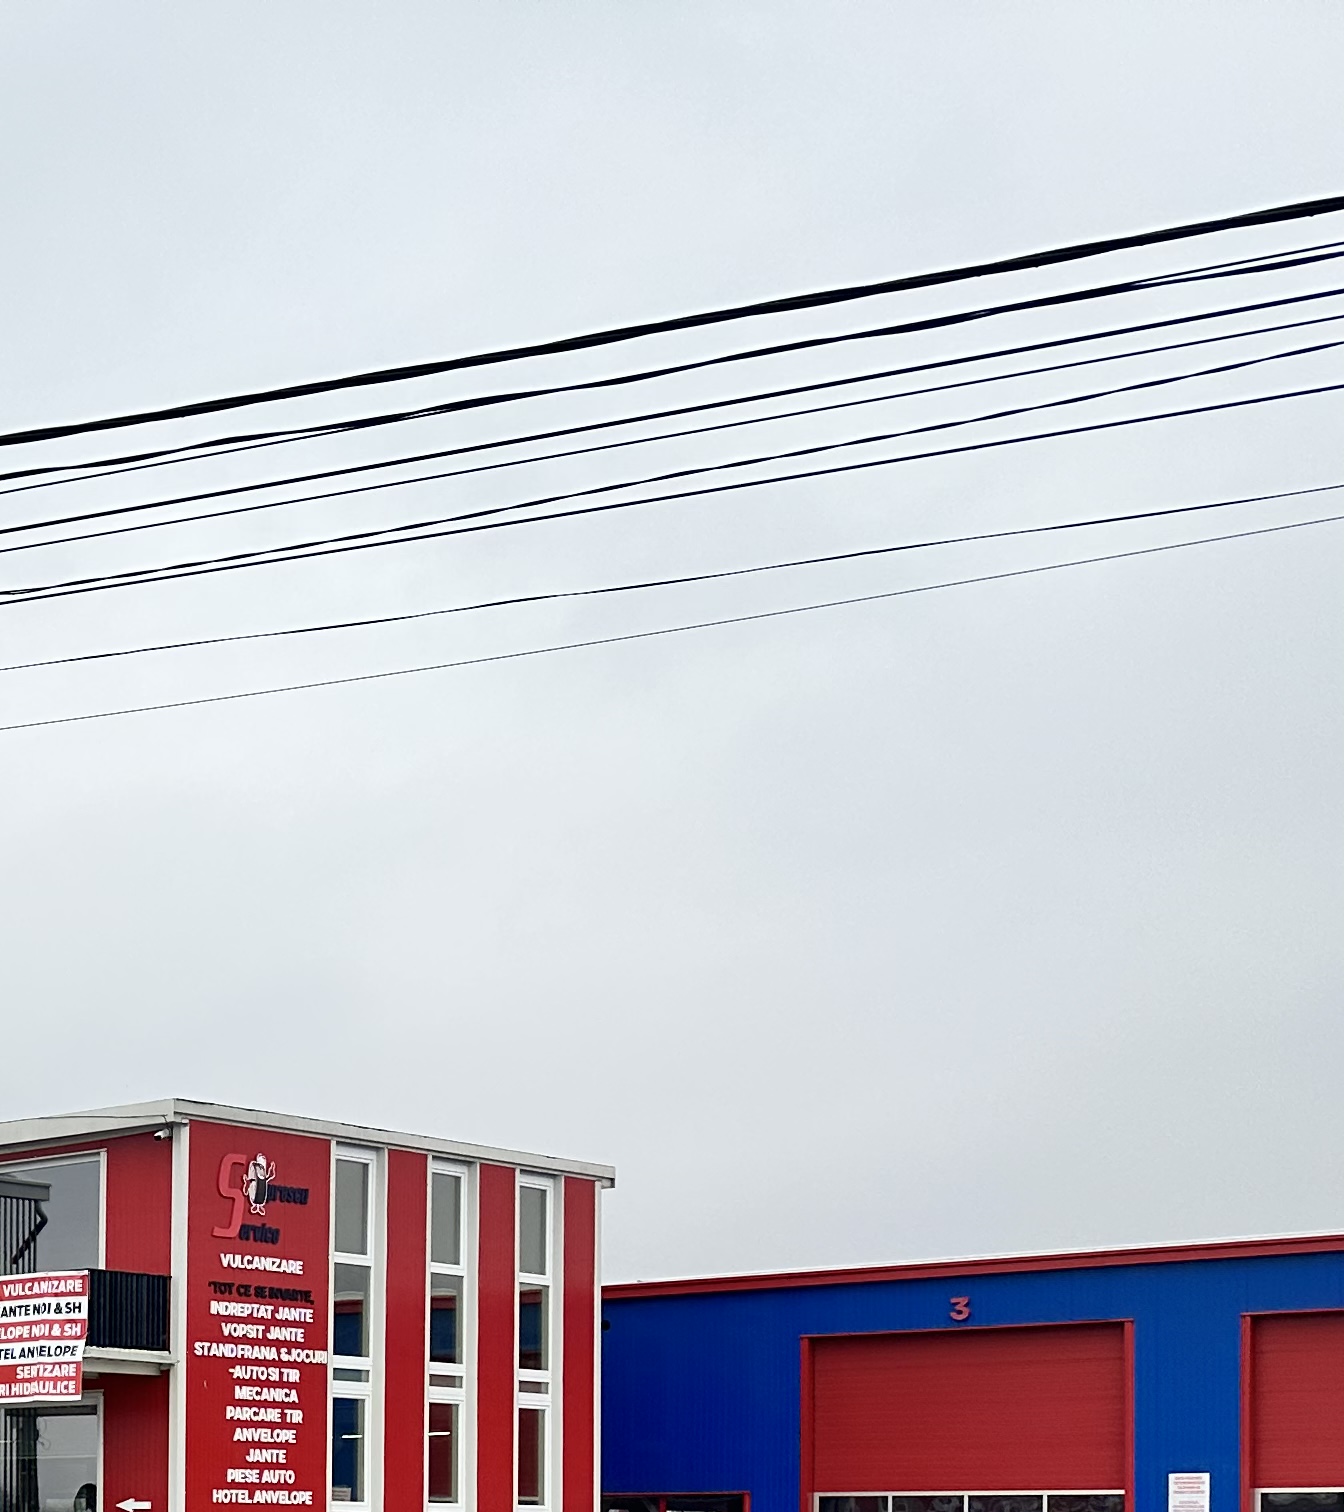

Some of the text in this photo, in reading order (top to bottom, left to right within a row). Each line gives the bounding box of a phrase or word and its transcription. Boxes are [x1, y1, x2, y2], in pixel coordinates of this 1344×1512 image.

[220, 1253, 304, 1275] VULCANIZARE
[2, 1279, 83, 1297] VULCANIZARE
[236, 1284, 252, 1298] CE
[254, 1286, 268, 1299] SE
[53, 1302, 63, 1314] &
[65, 1302, 82, 1314] SH
[210, 1300, 314, 1322] INDREPTAT JANTE
[950, 1296, 970, 1321] 3
[51, 1323, 61, 1336] &
[63, 1323, 81, 1336] SH
[221, 1322, 305, 1342] VOPSIT JANTE
[194, 1342, 237, 1358] STAND
[237, 1344, 279, 1361] FRANA
[268, 1367, 279, 1381] SI
[280, 1368, 300, 1383] TIR
[234, 1385, 299, 1403] MECANICA
[226, 1406, 303, 1423] PARCARE TIR
[233, 1427, 296, 1443] ANVELOPE
[246, 1448, 287, 1463] JANTE
[227, 1468, 295, 1484] PIESE AUTO
[212, 1489, 312, 1505] HOTEL ANVELOPE
